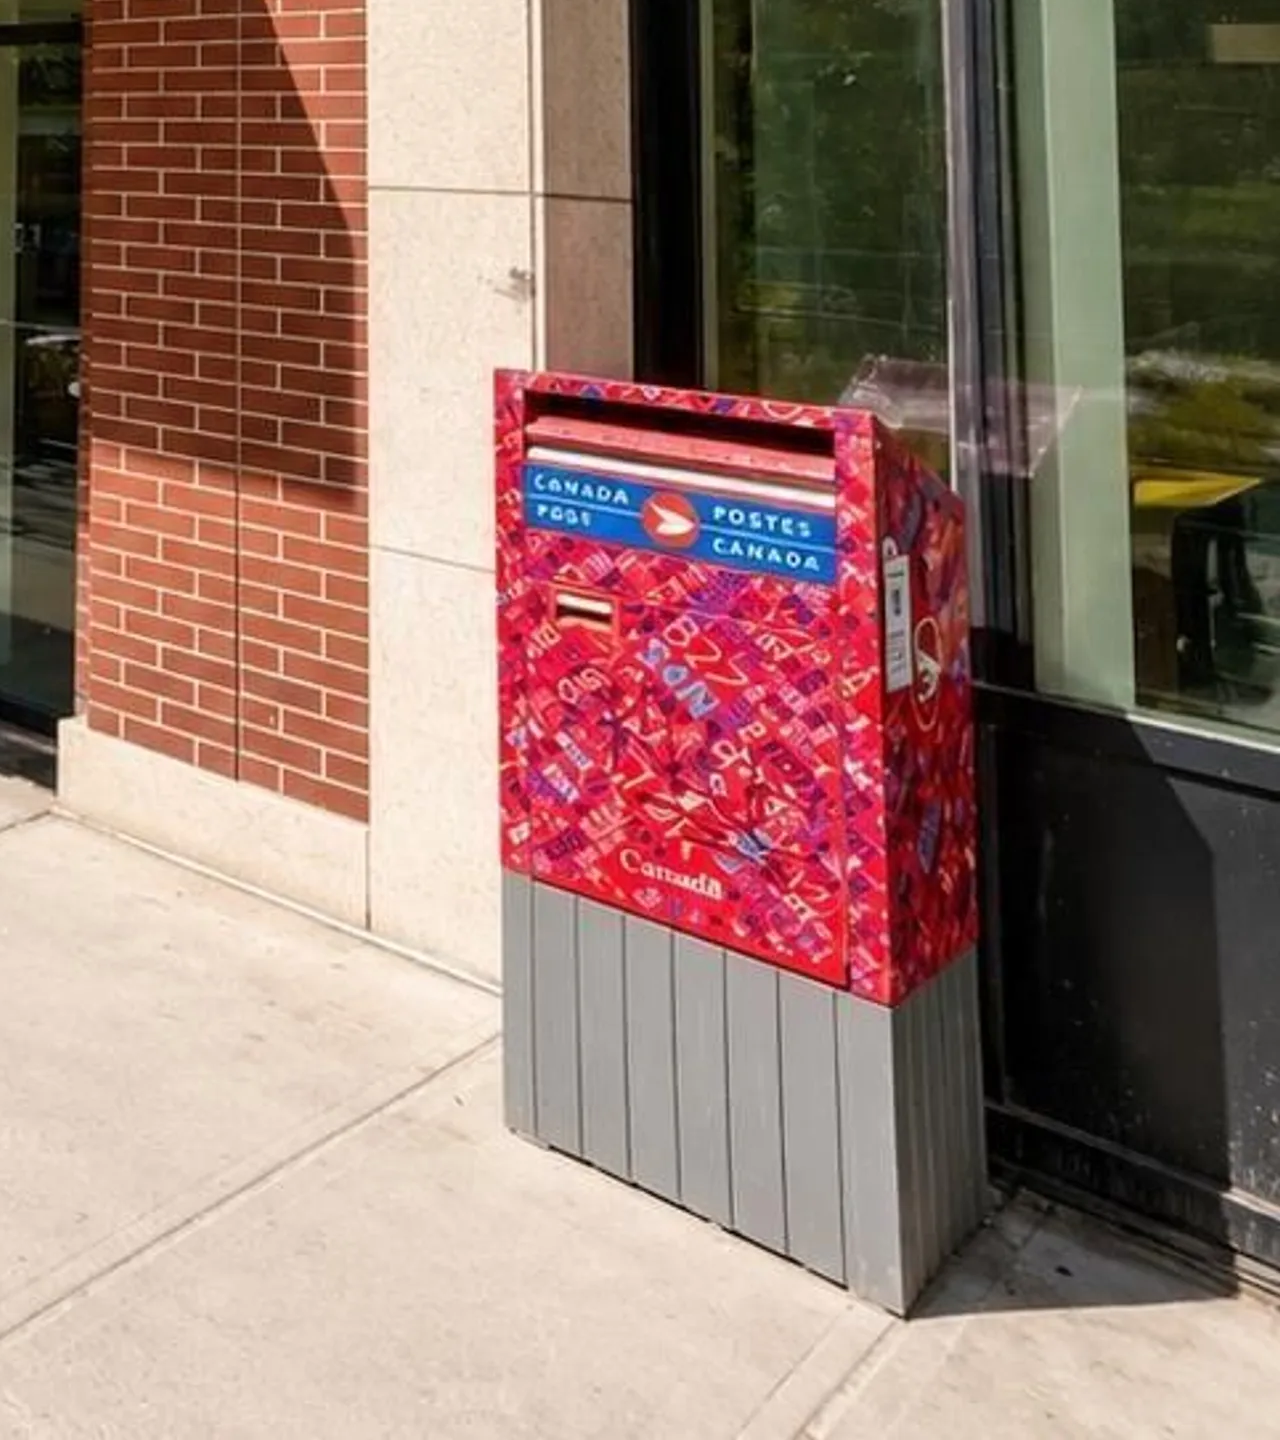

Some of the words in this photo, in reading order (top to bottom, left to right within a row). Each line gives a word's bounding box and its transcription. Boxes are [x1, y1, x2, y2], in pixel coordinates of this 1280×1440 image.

[533, 473, 629, 506] CANADA
[712, 505, 811, 538] POSTES
[712, 537, 821, 572] CANADA
